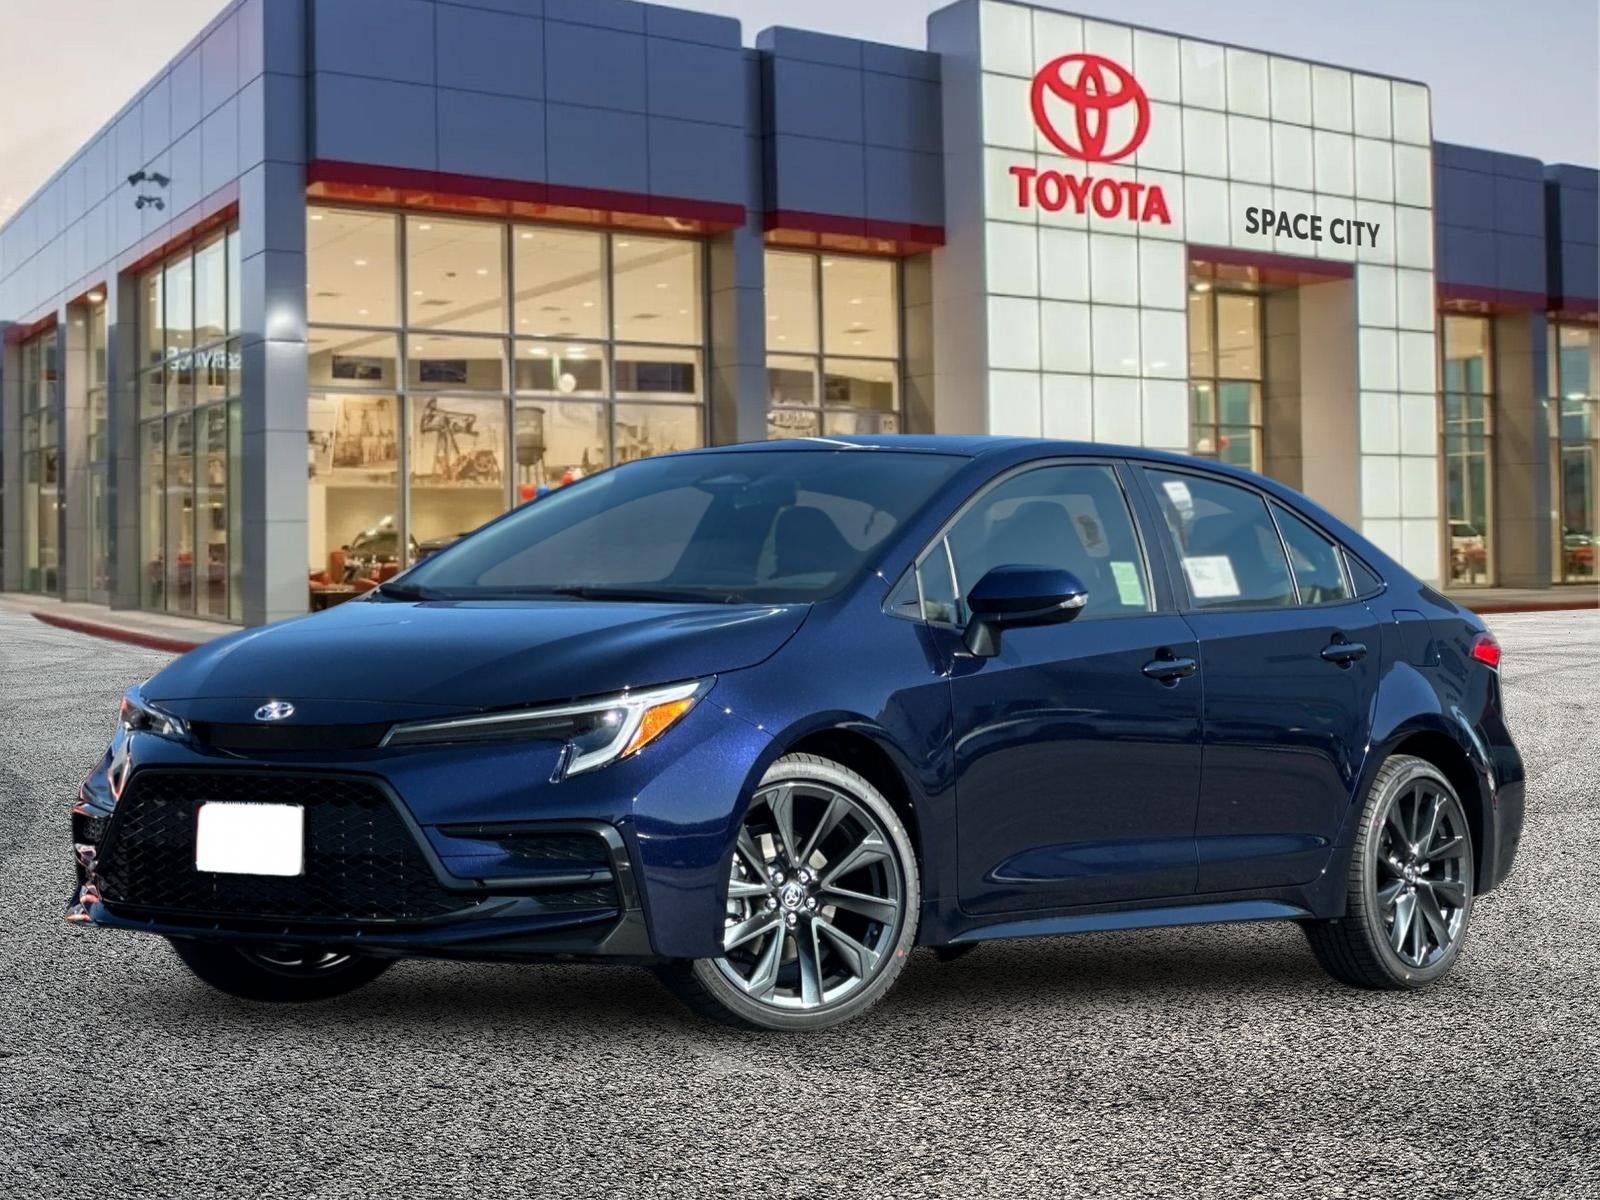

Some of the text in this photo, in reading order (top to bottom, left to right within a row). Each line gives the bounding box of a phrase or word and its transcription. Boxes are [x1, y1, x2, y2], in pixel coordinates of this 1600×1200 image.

[1010, 166, 1171, 225] TOYOTA
[1245, 206, 1380, 248] SPACE CITY
